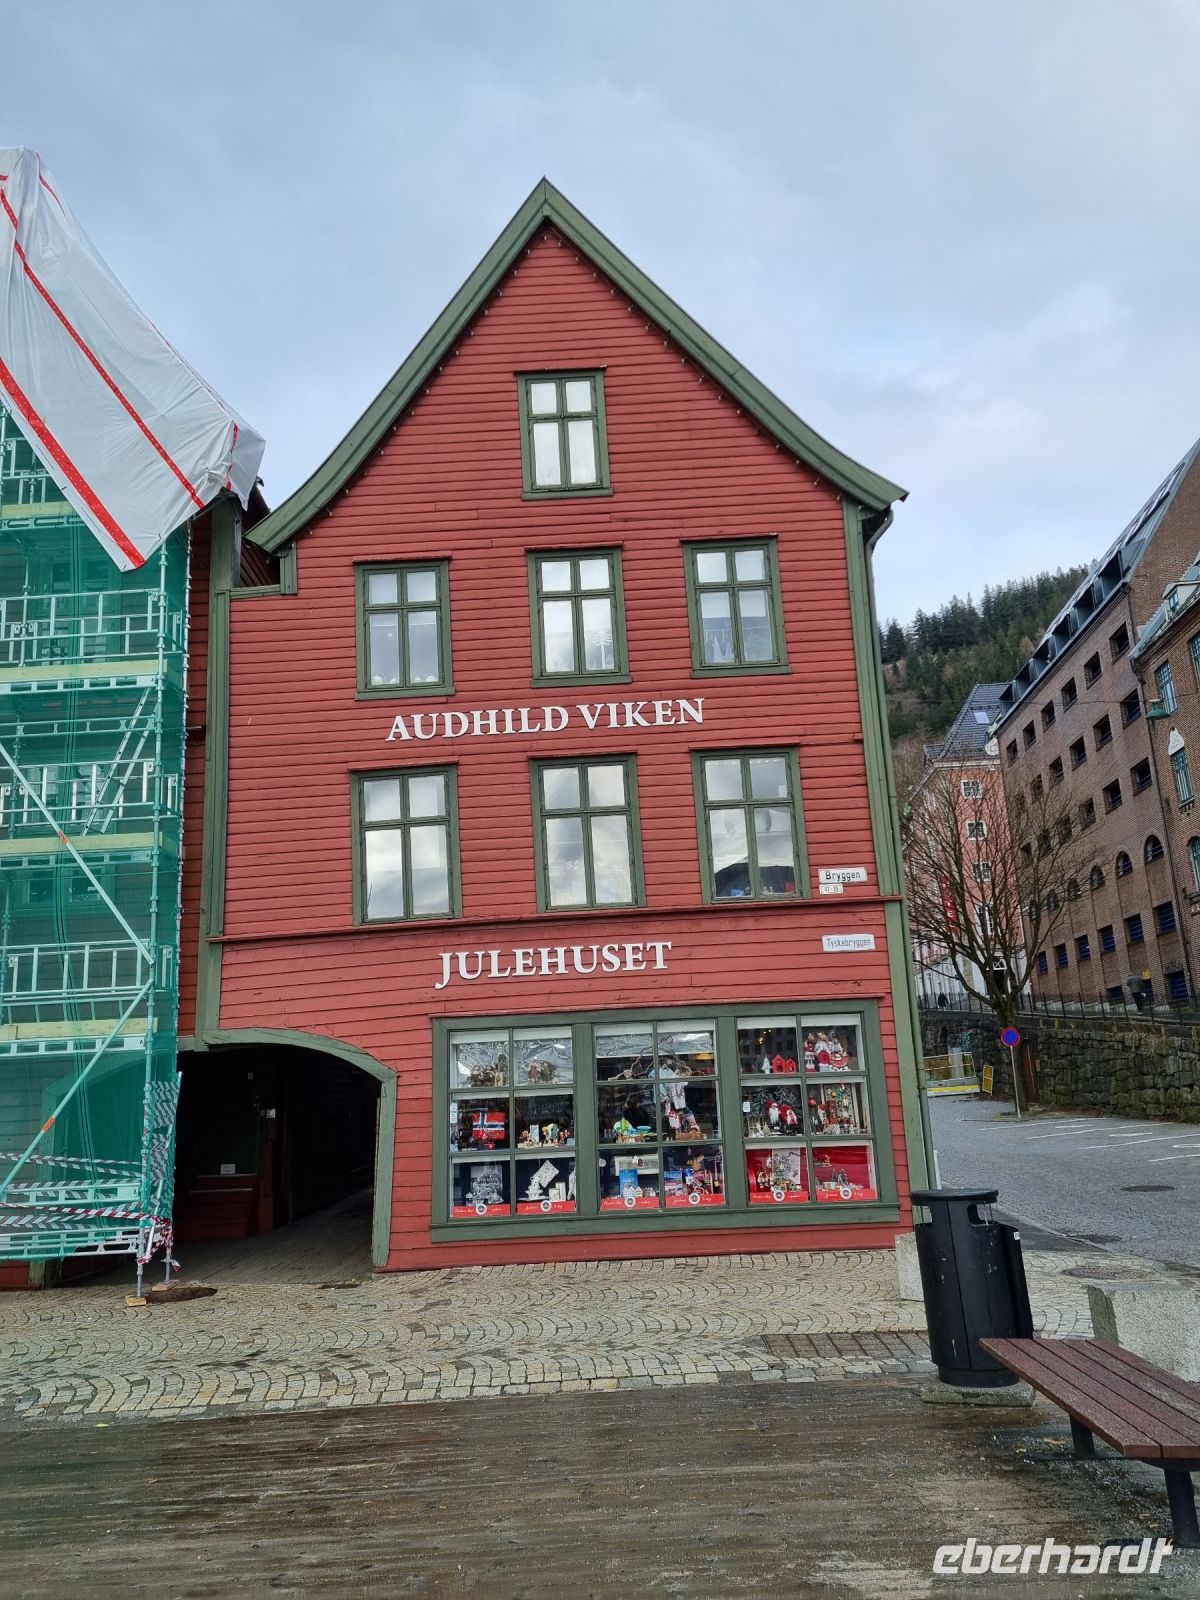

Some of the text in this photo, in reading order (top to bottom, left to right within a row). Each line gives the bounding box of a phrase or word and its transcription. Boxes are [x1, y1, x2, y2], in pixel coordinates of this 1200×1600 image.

[385, 698, 705, 741] AUDHILD VIKEN
[825, 871, 861, 882] Bryggen
[826, 938, 871, 949] Tyskebryggen
[434, 941, 672, 990] JULEHUSET
